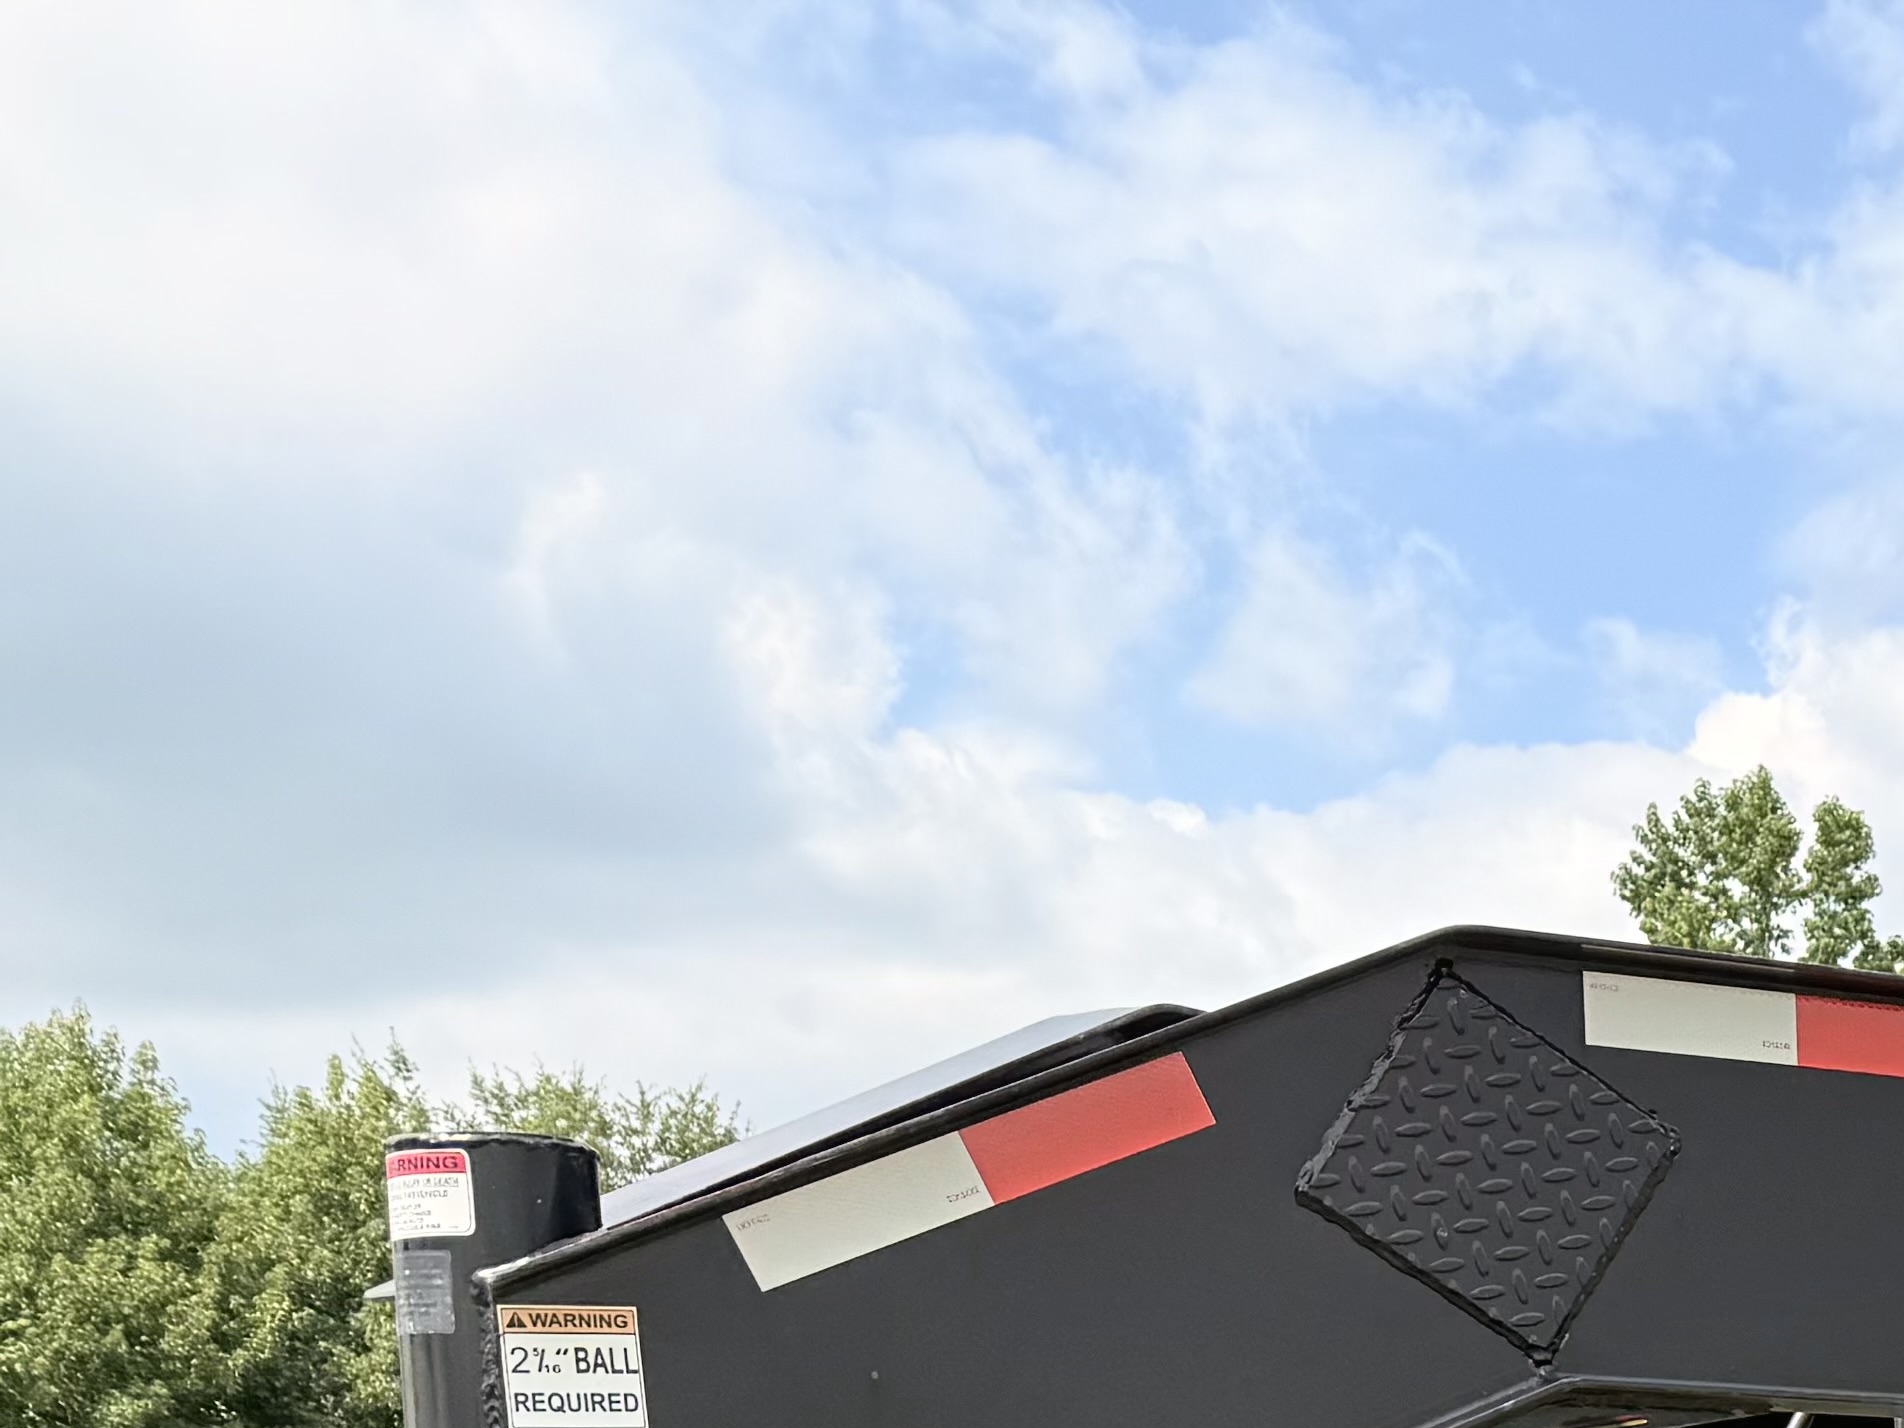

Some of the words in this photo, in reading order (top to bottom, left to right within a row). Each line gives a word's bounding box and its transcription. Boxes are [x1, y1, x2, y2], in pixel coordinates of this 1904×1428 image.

[528, 1312, 628, 1328] WARNING
[574, 1347, 640, 1374] BALL
[513, 1392, 640, 1413] REQUIRED
